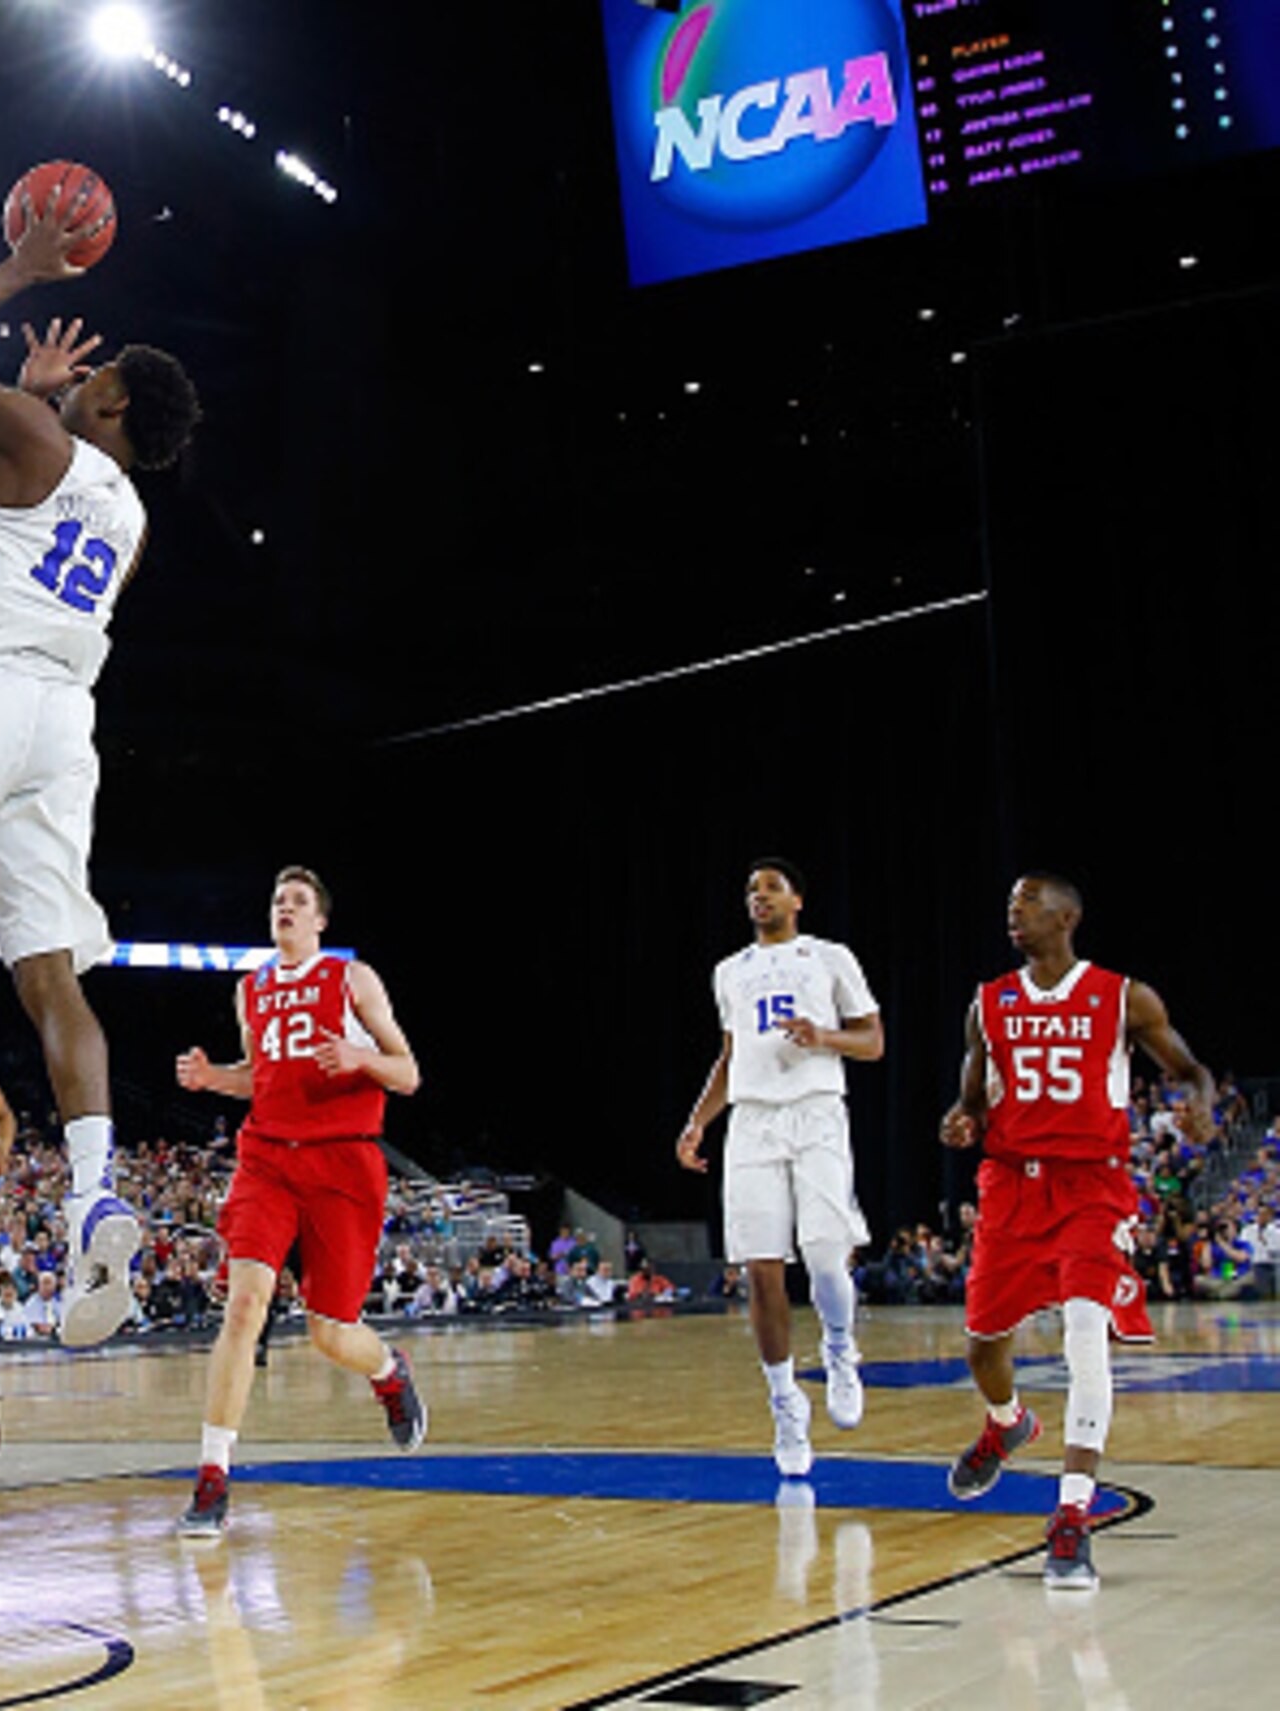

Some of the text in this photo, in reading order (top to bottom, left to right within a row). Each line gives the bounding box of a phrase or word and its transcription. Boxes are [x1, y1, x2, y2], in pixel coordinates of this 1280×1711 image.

[650, 51, 897, 182] NCAA
[30, 517, 117, 613] 12
[256, 985, 320, 1015] UTAH
[757, 994, 794, 1034] 15
[261, 1012, 317, 1061] 42
[1004, 1015, 1092, 1041] UTAH
[1011, 1046, 1083, 1103] 55
